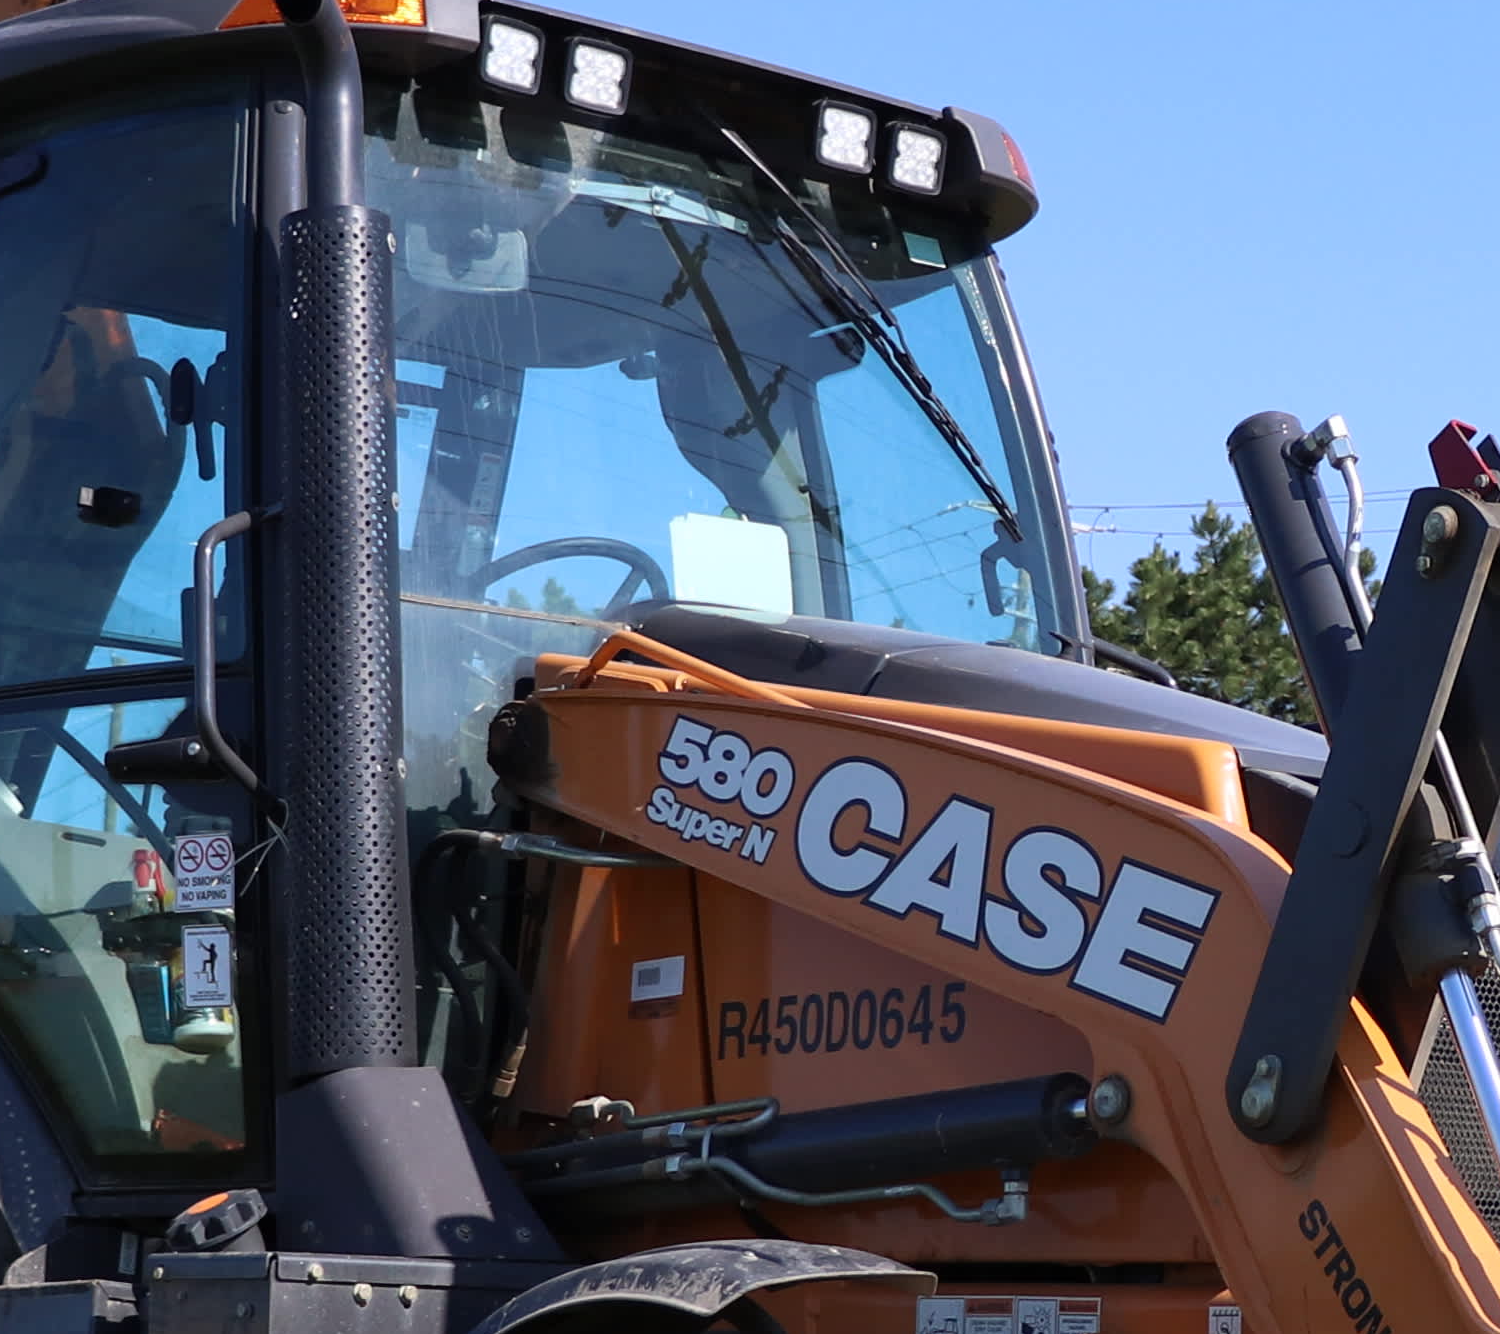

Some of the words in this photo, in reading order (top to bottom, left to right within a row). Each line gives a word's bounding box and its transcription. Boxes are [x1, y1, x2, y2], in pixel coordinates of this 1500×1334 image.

[658, 714, 796, 819] 580
[646, 784, 744, 853] Super
[739, 822, 778, 865] N
[178, 877, 190, 888] NO
[182, 890, 194, 901] NO
[196, 889, 227, 900] VAPING
[795, 755, 1222, 1025] CASE
[717, 982, 967, 1060] R450D0645
